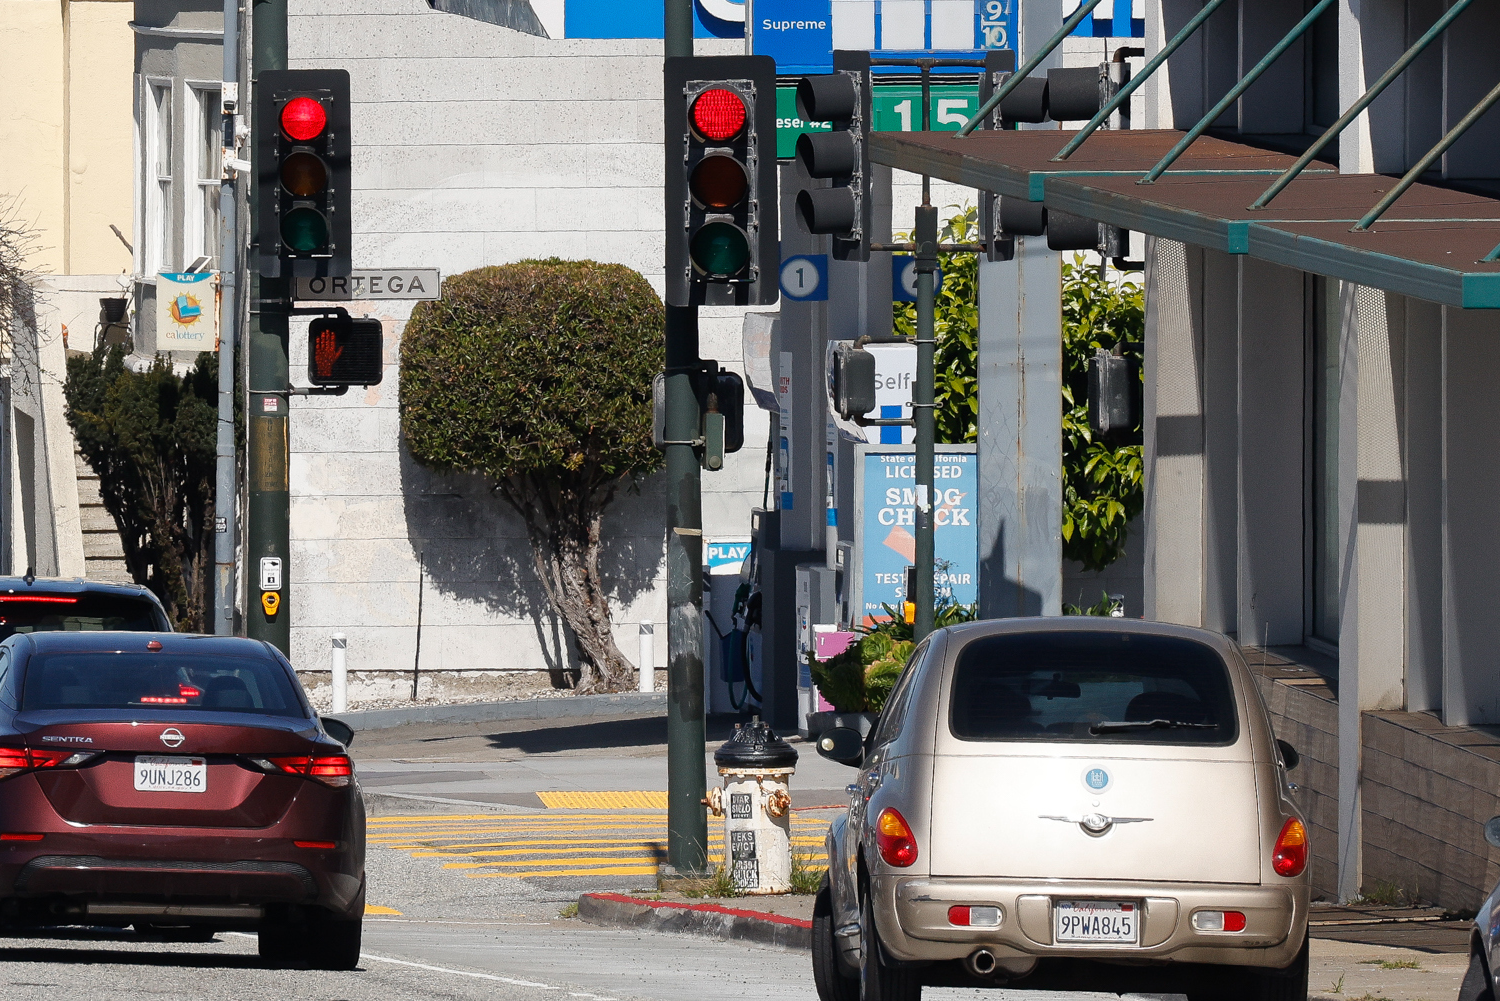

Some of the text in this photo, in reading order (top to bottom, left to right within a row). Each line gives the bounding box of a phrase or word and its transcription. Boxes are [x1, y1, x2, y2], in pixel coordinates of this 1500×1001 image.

[762, 19, 827, 32] Supreme
[176, 273, 195, 281] PLAY
[795, 267, 804, 288] 1
[309, 276, 426, 294] ORTEGA
[874, 372, 911, 390] Self
[880, 455, 905, 463] State
[886, 465, 962, 479] LICESED
[877, 507, 970, 526] CHCK
[708, 546, 748, 560] PLAY
[933, 573, 972, 585] EPAIR
[865, 602, 877, 610] No
[140, 769, 201, 787] 9UNJ286
[1074, 903, 1121, 916] California
[1061, 915, 1131, 935] 9PWA845
